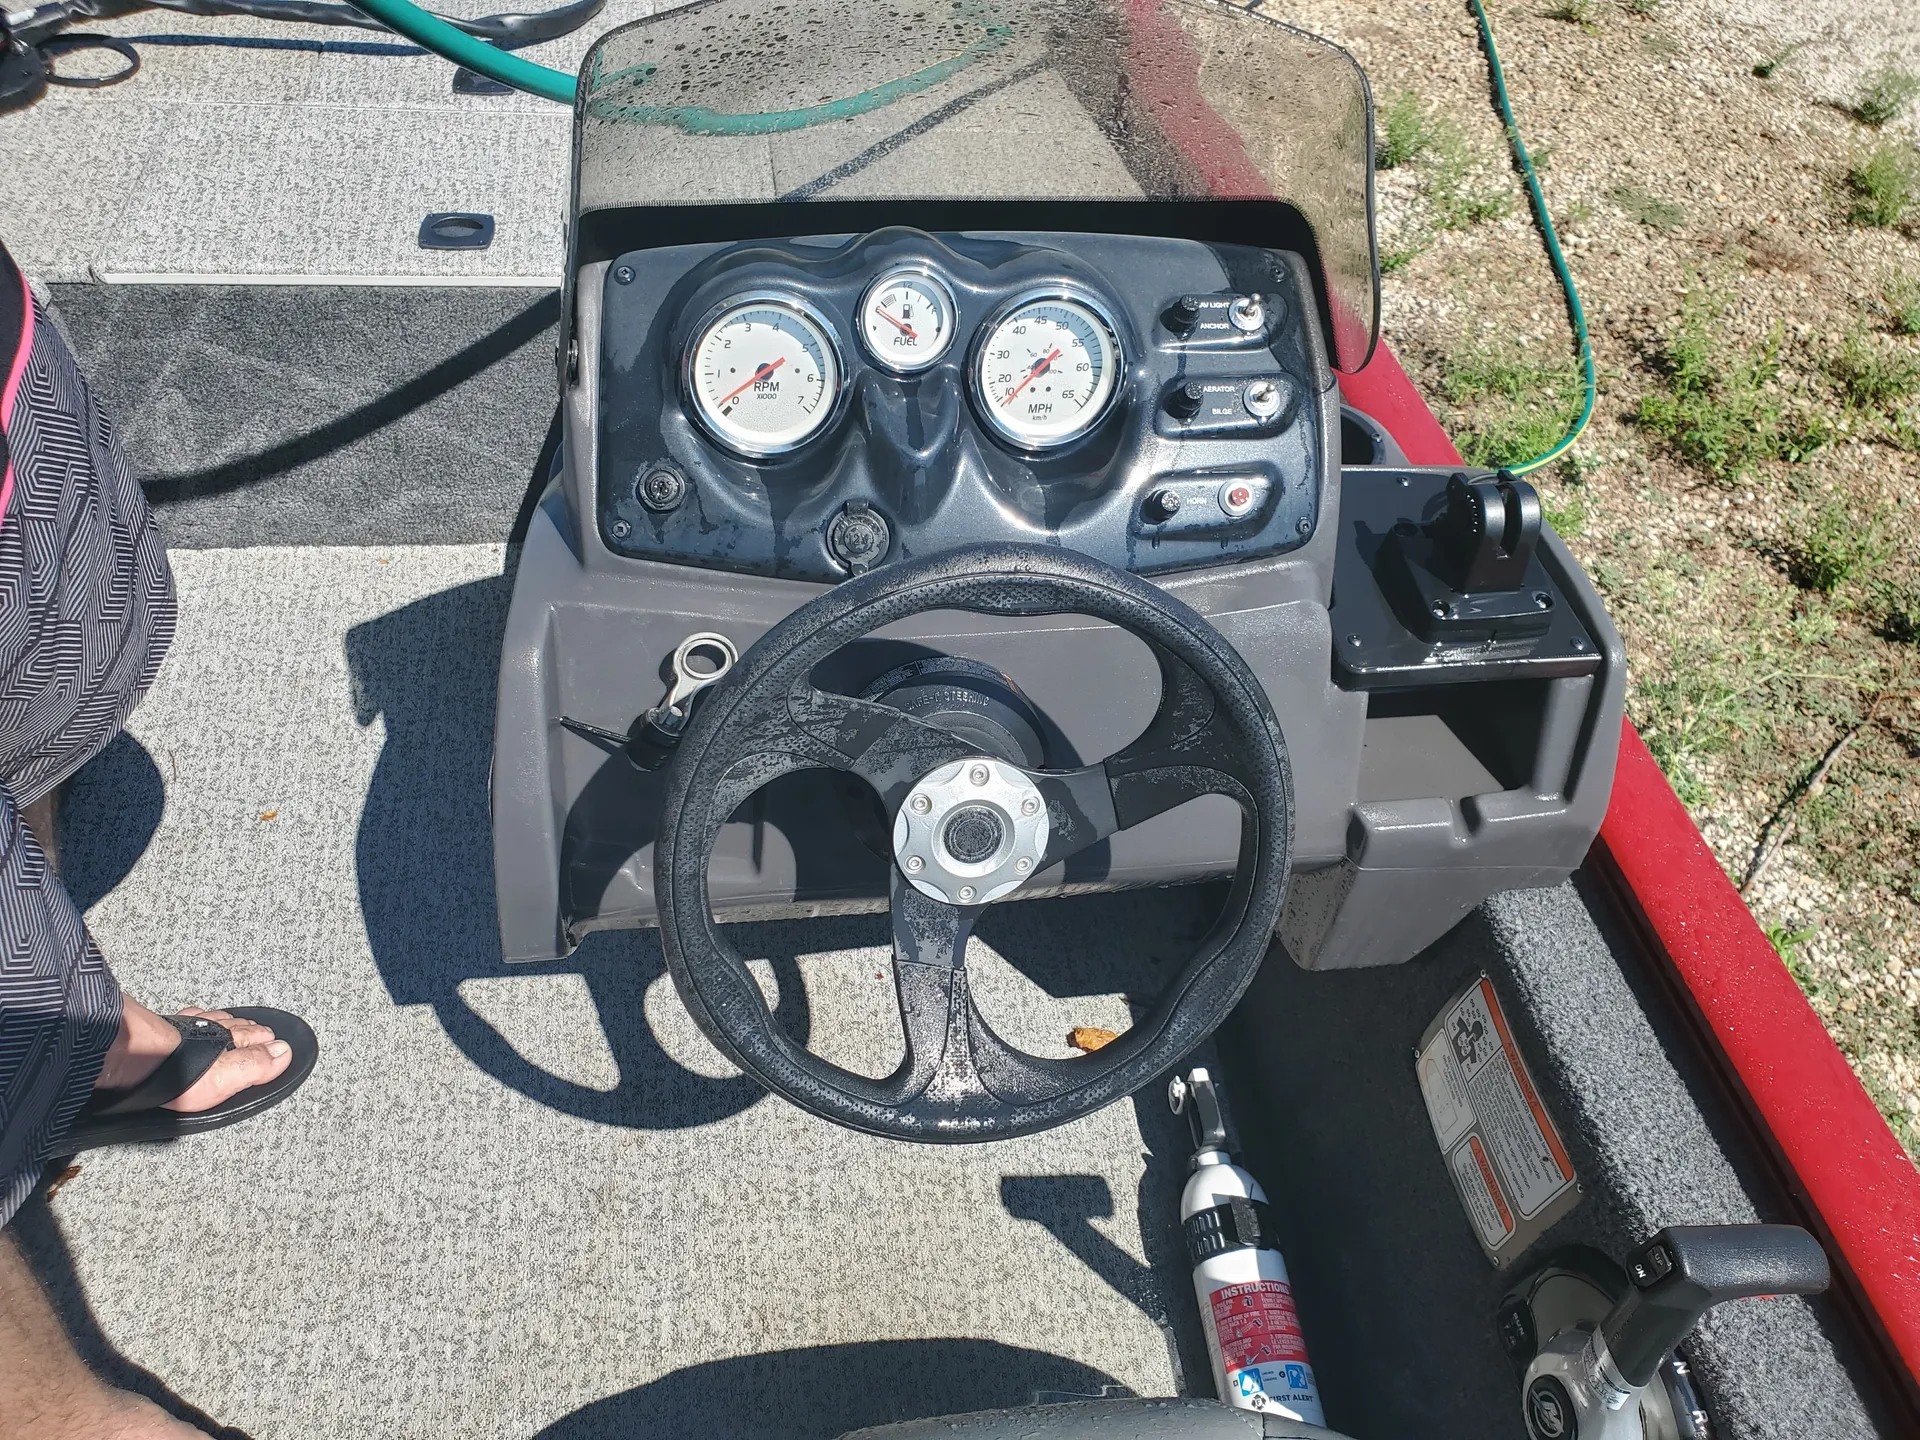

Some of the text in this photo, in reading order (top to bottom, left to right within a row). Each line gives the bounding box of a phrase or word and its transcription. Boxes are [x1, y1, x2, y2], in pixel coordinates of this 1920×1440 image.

[1034, 315, 1048, 325] 45
[744, 323, 752, 333] 3
[772, 323, 780, 332] 4
[1012, 325, 1026, 335] 40
[1055, 321, 1070, 331] 50
[1200, 322, 1230, 330] ANCHOR
[724, 339, 732, 349] 2
[893, 337, 918, 347] FUEL
[1071, 338, 1085, 348] 55
[801, 343, 809, 353] 5
[996, 350, 1010, 360] 30
[1076, 362, 1090, 372] 60
[807, 373, 814, 383] 6
[998, 373, 1012, 383] 20
[753, 381, 780, 392] RPM
[1004, 387, 1015, 396] 10
[1202, 385, 1235, 393] AERATOR
[1061, 389, 1075, 399] 65
[732, 396, 740, 405] 0
[797, 395, 805, 405] 7
[1028, 403, 1053, 414] MPH
[1186, 497, 1207, 505] HORN
[943, 690, 990, 706] STEERING
[1508, 1049, 1534, 1101] WARNING
[1635, 1264, 1646, 1278] DN
[1221, 1283, 1290, 1299] INSTRUCTIONS
[1673, 1361, 1690, 1375] N
[1269, 1393, 1313, 1403] FIRST ALERT
[1692, 1410, 1708, 1424] R
